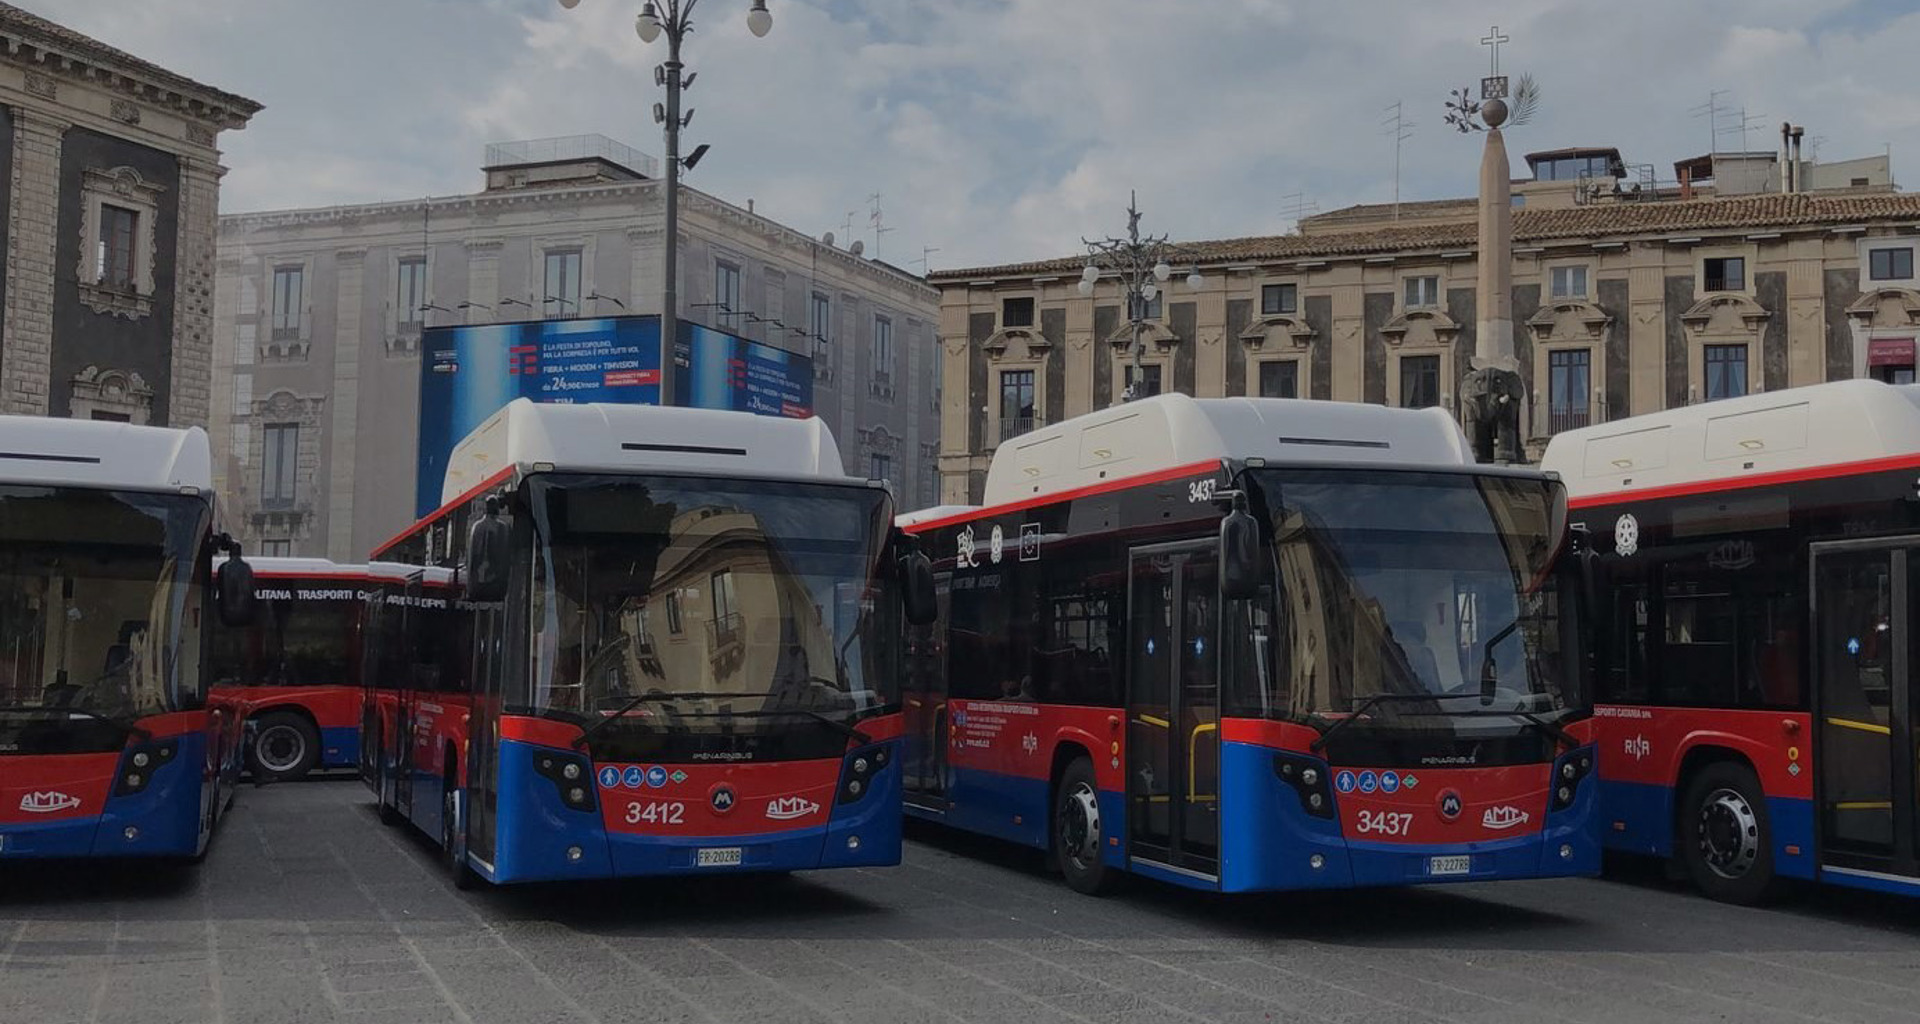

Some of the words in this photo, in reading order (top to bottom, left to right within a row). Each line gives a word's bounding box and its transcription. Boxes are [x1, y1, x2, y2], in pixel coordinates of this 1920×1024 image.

[597, 348, 609, 356] PER
[610, 347, 628, 355] TUTTI
[543, 366, 564, 374] FIBRA
[569, 363, 597, 372] MODEM
[603, 360, 639, 370] TIMVISION
[297, 589, 353, 600] TRASPORTI
[713, 792, 732, 805] M
[1443, 799, 1459, 811] M
[624, 801, 685, 825] 3412
[1356, 810, 1414, 836] 3437
